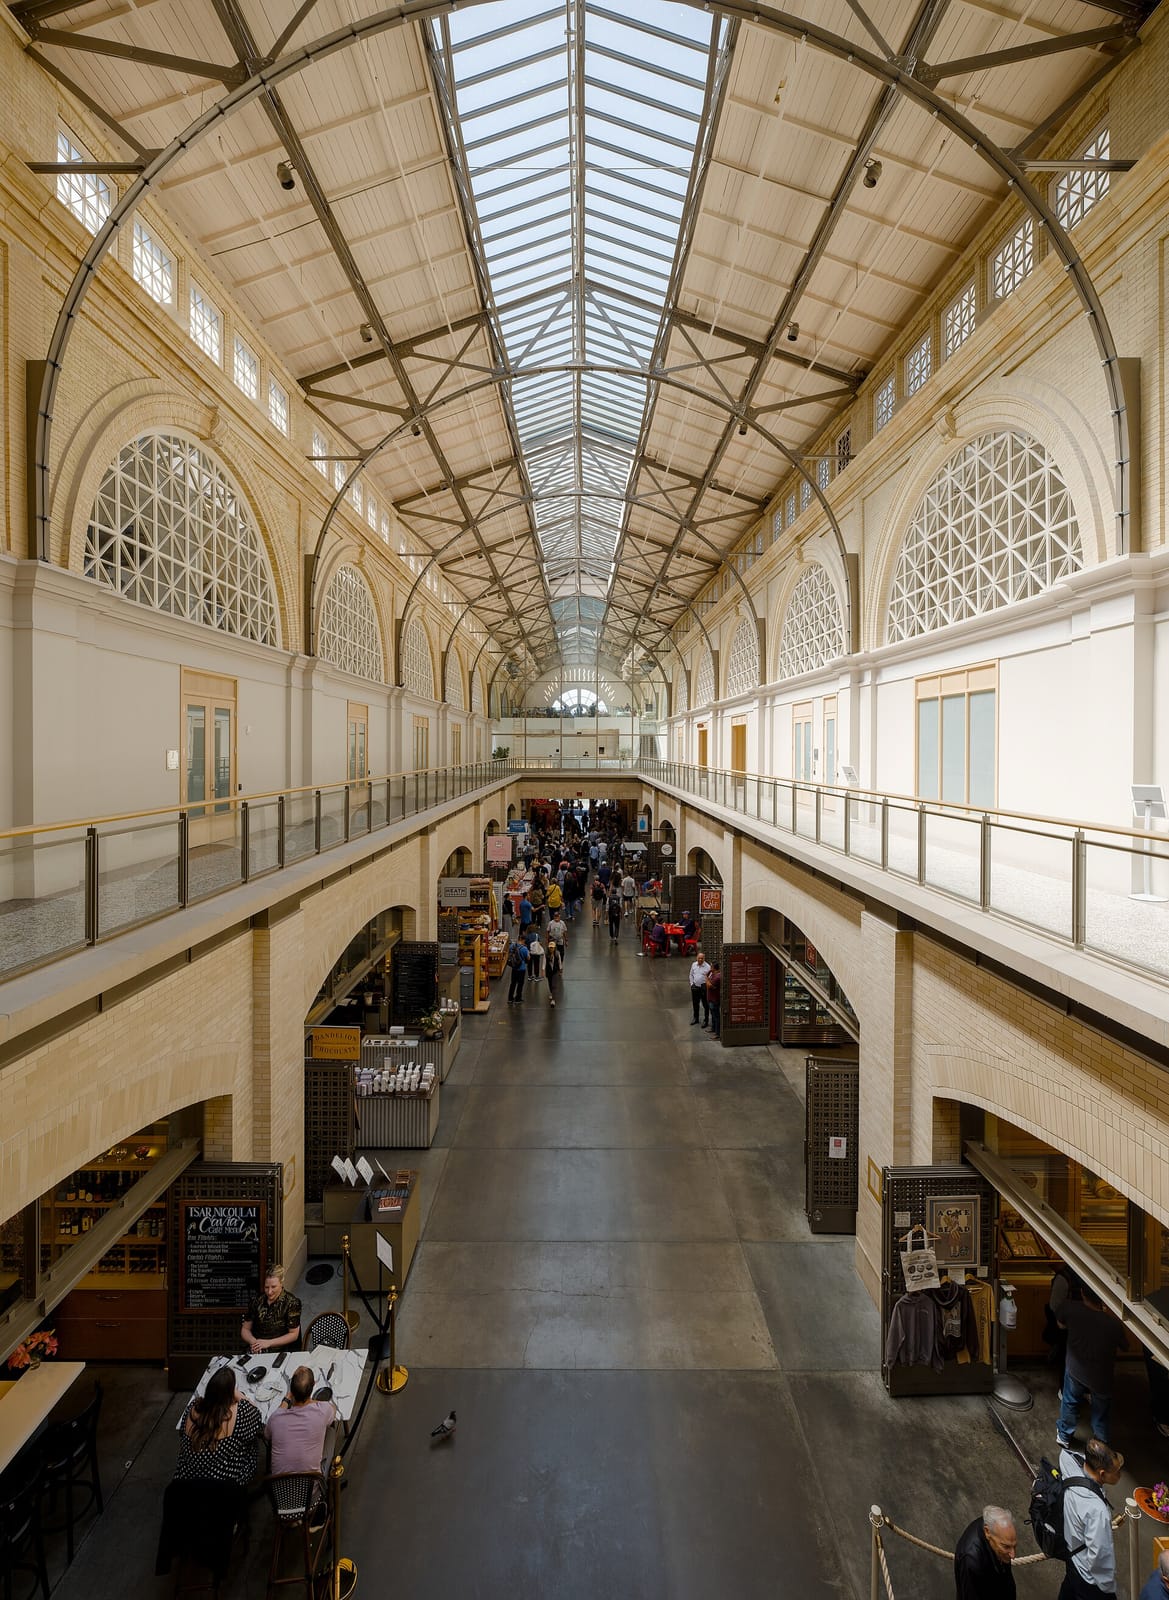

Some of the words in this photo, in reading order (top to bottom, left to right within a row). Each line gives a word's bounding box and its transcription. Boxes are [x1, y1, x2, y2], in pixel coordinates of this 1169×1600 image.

[315, 1032, 357, 1042] DANDELION
[315, 1046, 356, 1054] CHOCOLATE
[189, 1207, 212, 1217] TSAR
[213, 1207, 256, 1217] NICOULAI
[199, 1215, 247, 1233] Caviar
